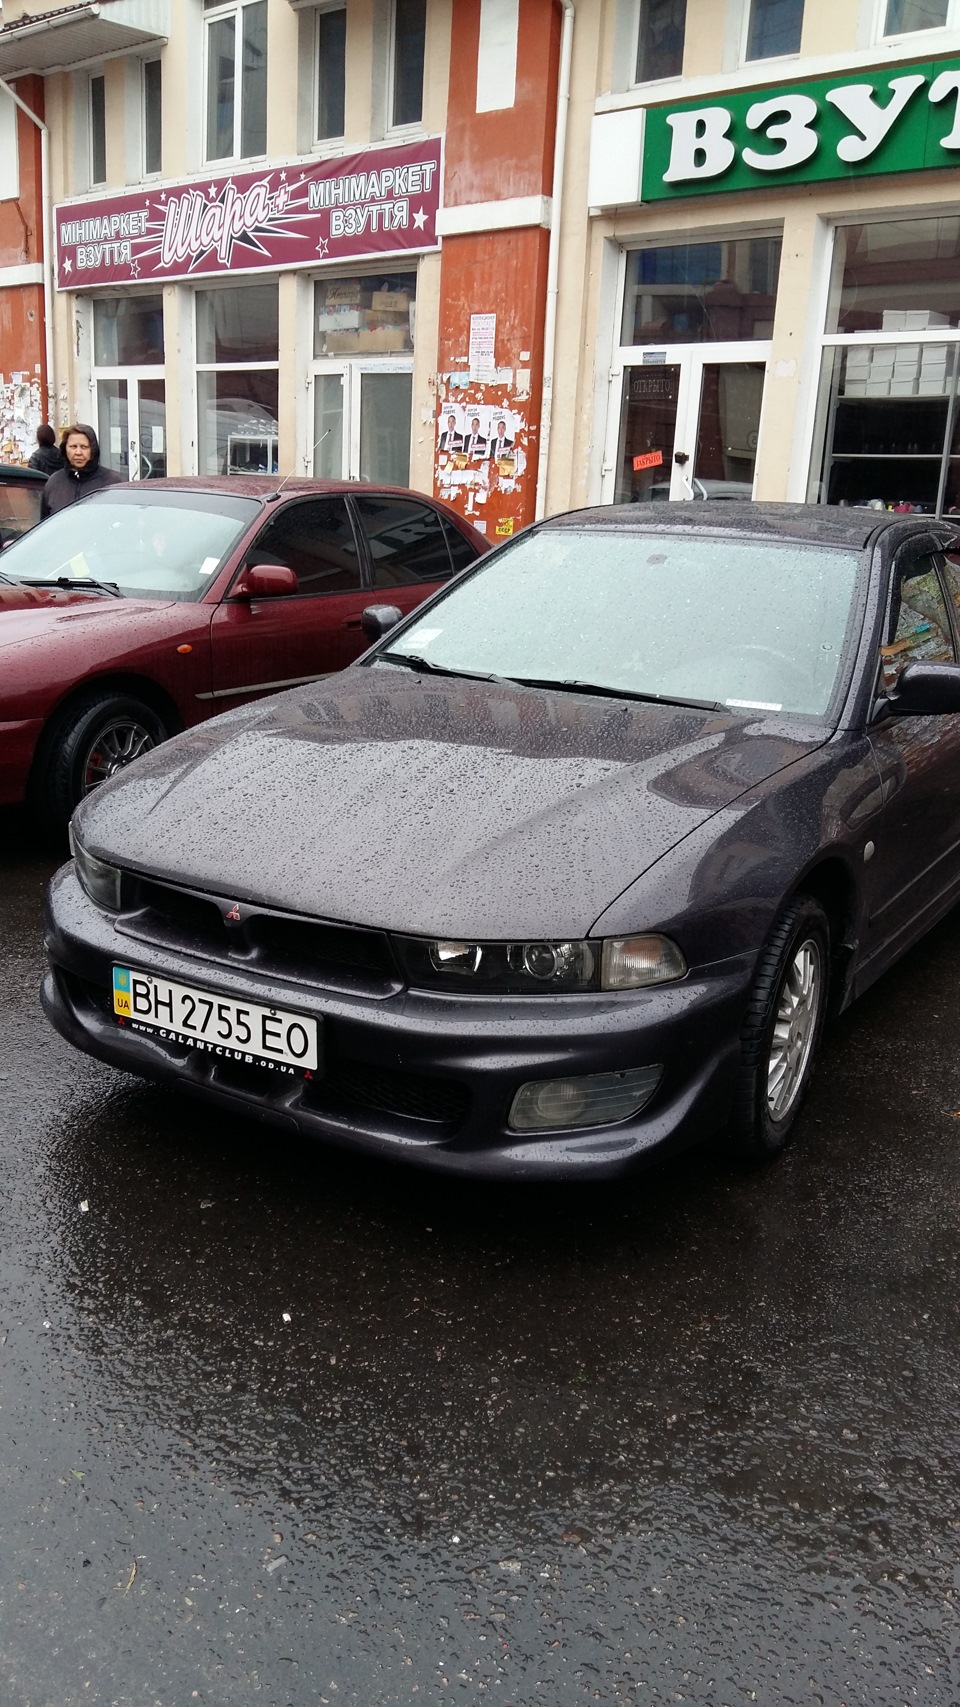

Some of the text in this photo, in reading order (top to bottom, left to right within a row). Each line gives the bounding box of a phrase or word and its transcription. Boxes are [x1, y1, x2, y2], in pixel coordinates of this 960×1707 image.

[308, 161, 437, 210] МІНІМАРКЕТ
[60, 209, 149, 247] МІНІМАРКЕТ
[329, 200, 409, 239] ВЗУТТЯ
[76, 241, 132, 270] ВЗУТТЯ
[117, 998, 130, 1011] UA
[132, 978, 309, 1059] BH 2755 EO
